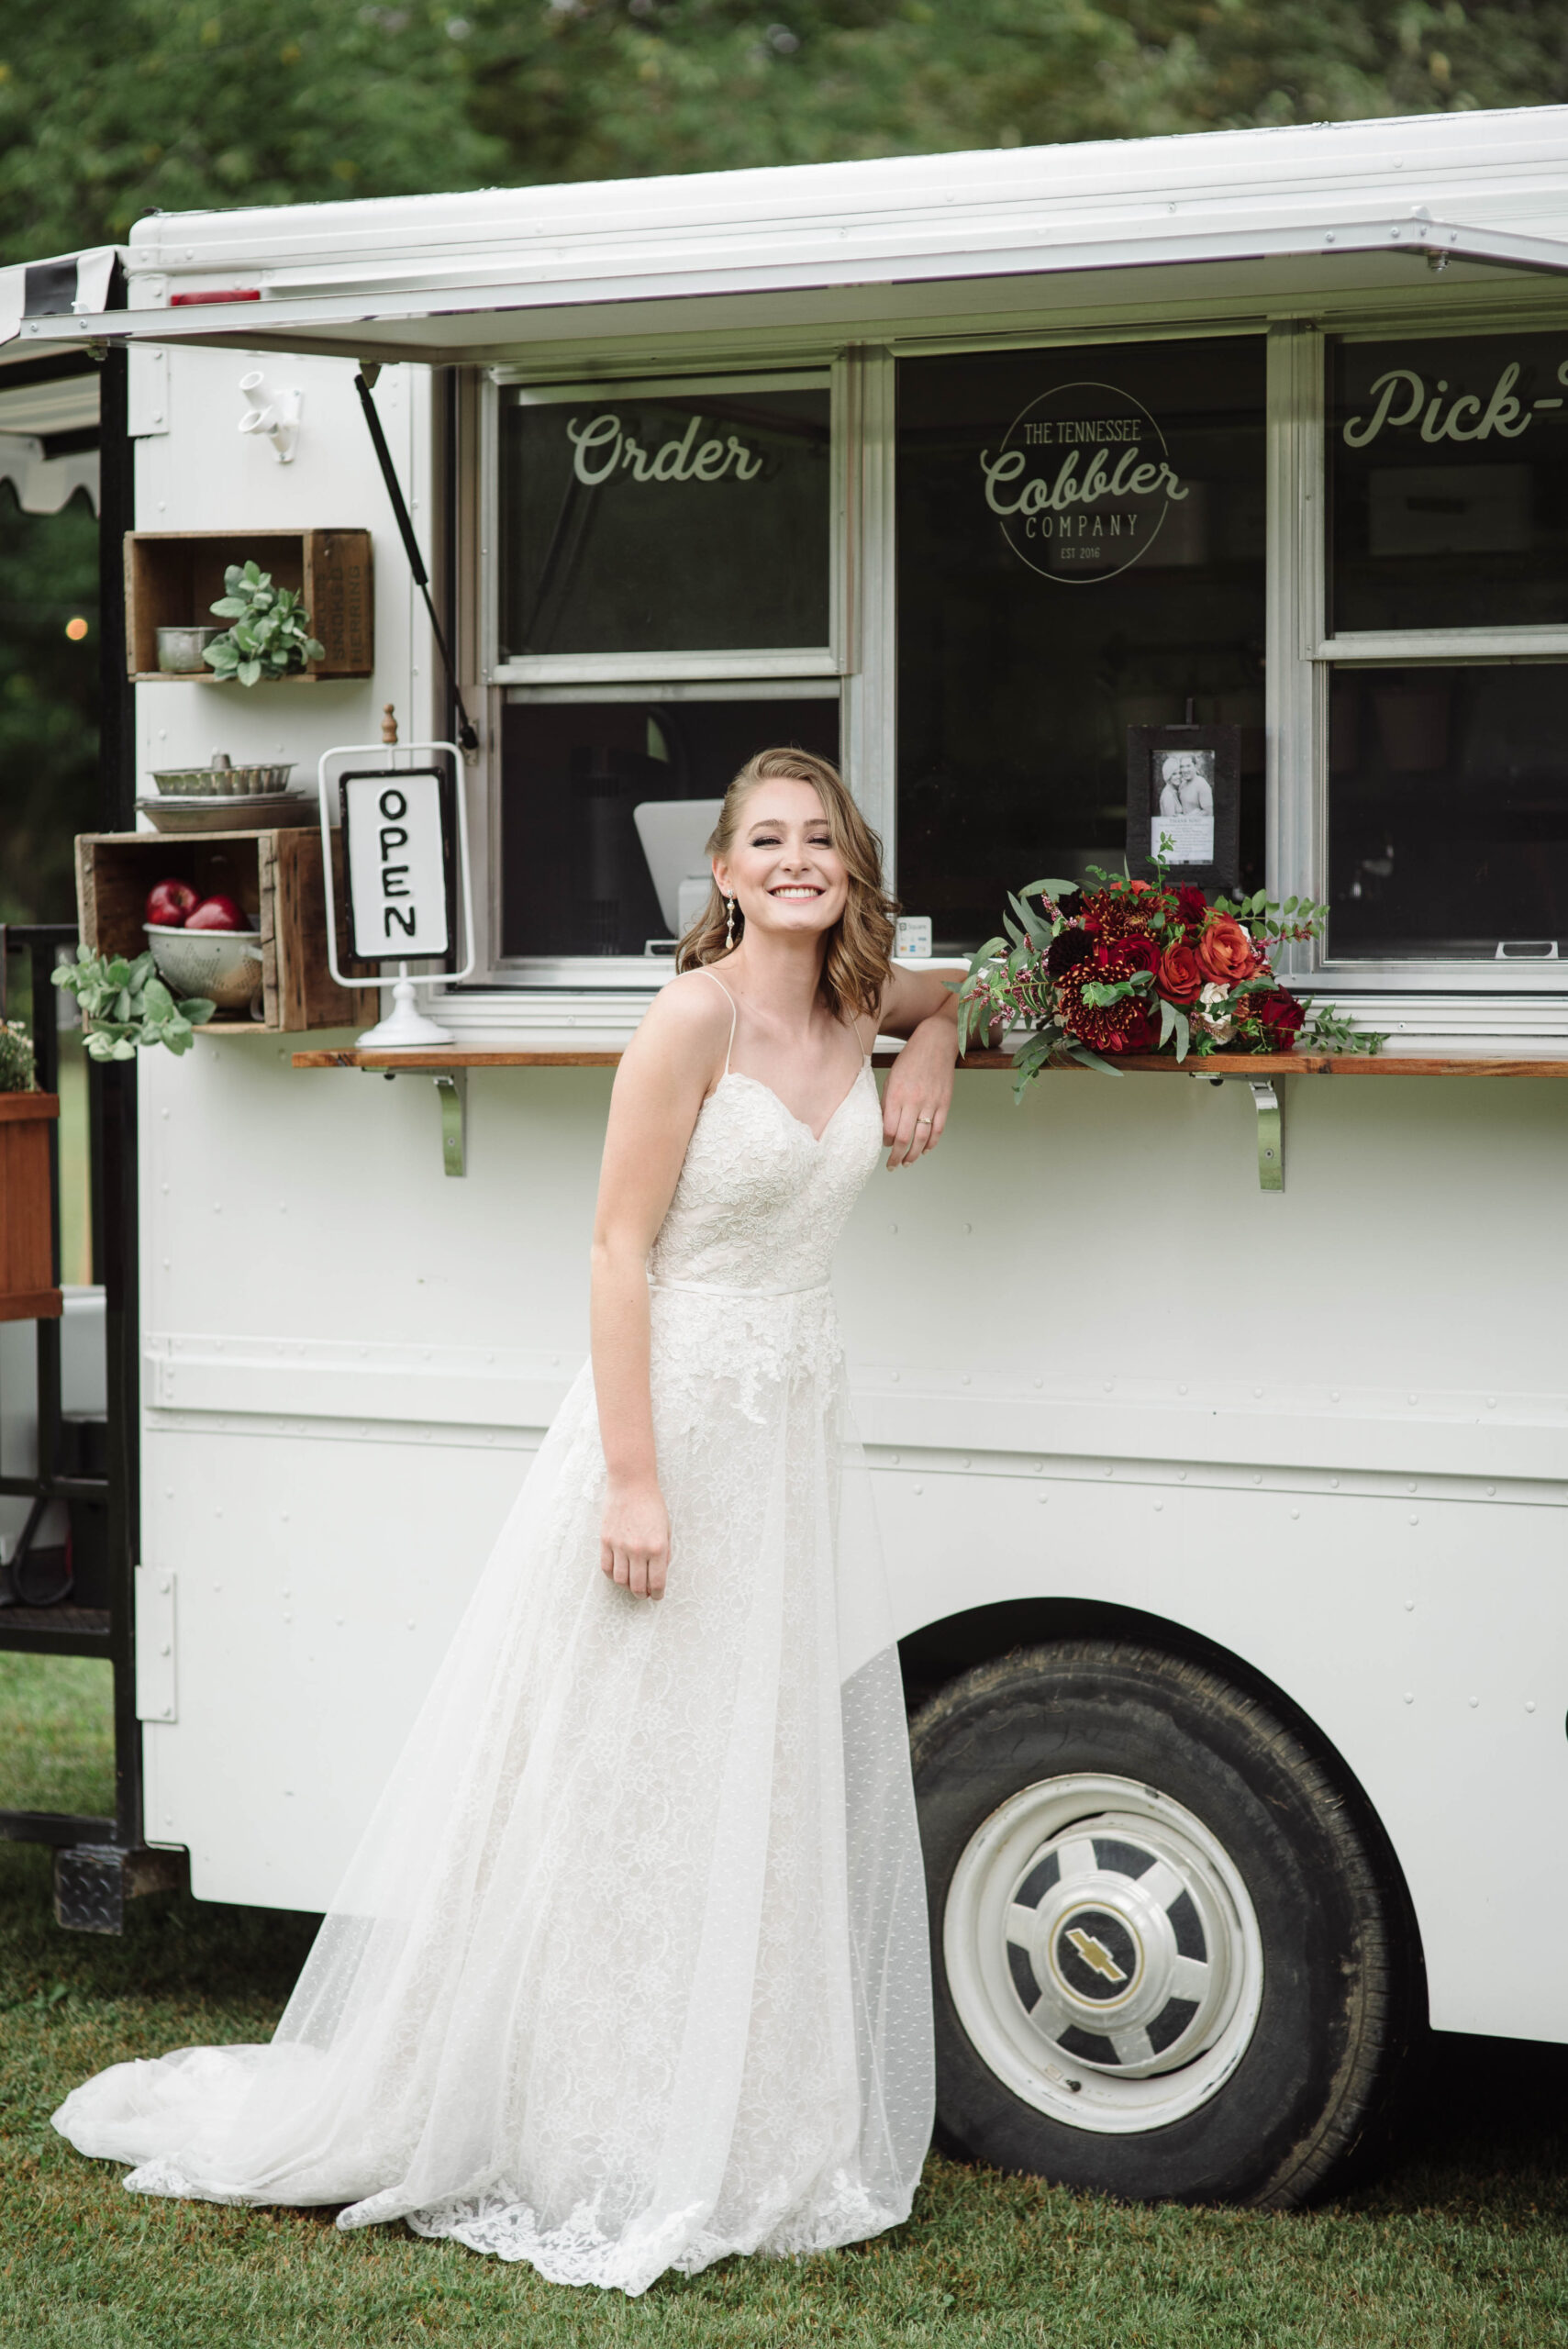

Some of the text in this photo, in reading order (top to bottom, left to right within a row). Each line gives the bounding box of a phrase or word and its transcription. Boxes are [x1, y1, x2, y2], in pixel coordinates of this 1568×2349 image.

[1024, 418, 1142, 445] THE TENNESSEE
[1342, 361, 1568, 449] Pick-
[567, 414, 762, 485] Order
[980, 447, 1189, 516] Cobbler
[1025, 514, 1138, 538] COMPANY
[1061, 547, 1100, 559] EST 2016
[329, 566, 345, 662] SMOKED
[348, 564, 363, 663] HERRING
[378, 788, 417, 939] OPEN
